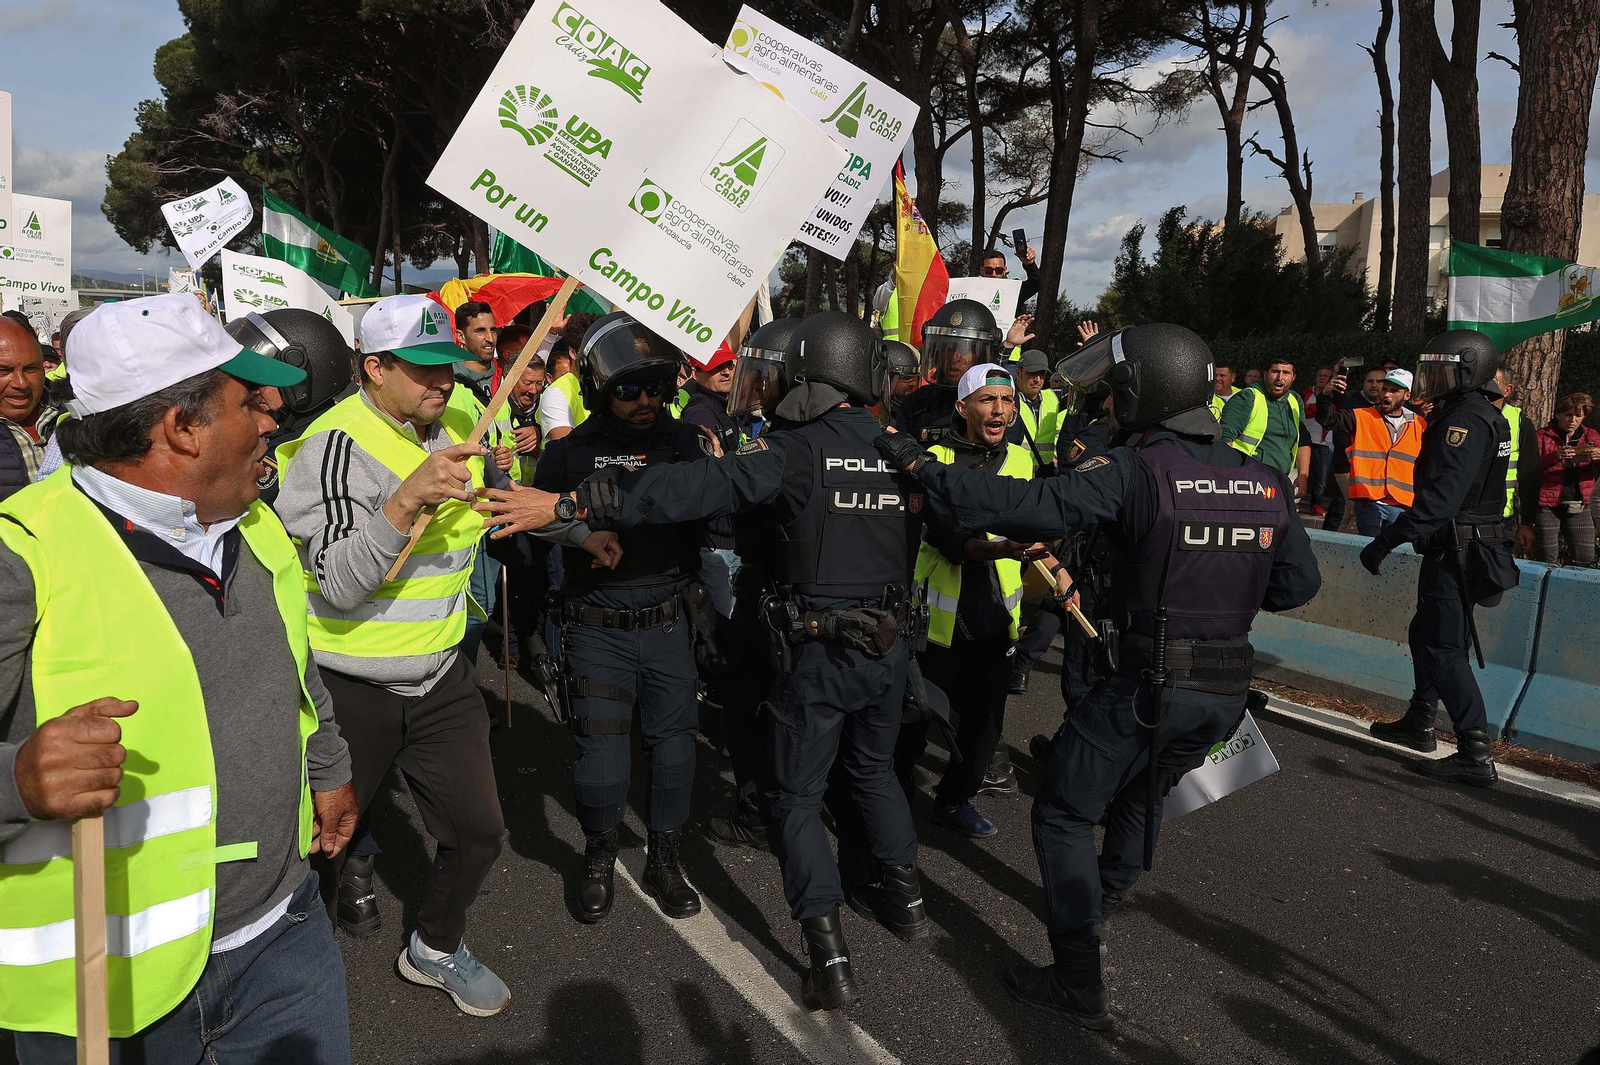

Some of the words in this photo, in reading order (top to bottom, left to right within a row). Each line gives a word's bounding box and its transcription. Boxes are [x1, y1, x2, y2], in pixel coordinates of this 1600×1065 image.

[552, 2, 651, 84] COAG
[758, 32, 824, 73] cooperativas
[749, 55, 782, 76] Andalucía
[753, 42, 839, 94] agro-alimentarias
[809, 86, 829, 102] Cádiz
[864, 103, 903, 133] ASAJA
[554, 136, 570, 150] Unión
[565, 114, 613, 160] UPA
[549, 142, 599, 178] AGRICULTORES
[553, 152, 595, 182] GANADEROS
[709, 166, 751, 201] ASAJA
[837, 172, 861, 190] CÁDIZ
[470, 168, 517, 210] Por
[514, 202, 549, 234] un
[187, 213, 205, 224] UPA
[671, 200, 740, 254] cooperativas
[193, 247, 207, 258] Por
[207, 240, 218, 249] un
[217, 221, 242, 240] Campo
[657, 222, 692, 250] Andalucía
[664, 210, 754, 278] agro-alimentarias
[0, 276, 37, 292] Campo
[40, 281, 65, 294] Vivo
[233, 264, 283, 281] COAG
[726, 271, 746, 288] Cádiz
[264, 294, 289, 307] UPA
[588, 247, 665, 311] Campo
[666, 298, 713, 343] Vivo
[594, 455, 636, 463] POLICIA
[834, 491, 905, 511] U.I.P.
[1175, 479, 1266, 496] POLICIA
[1184, 525, 1255, 546] UIP
[1210, 733, 1255, 765] COAG
